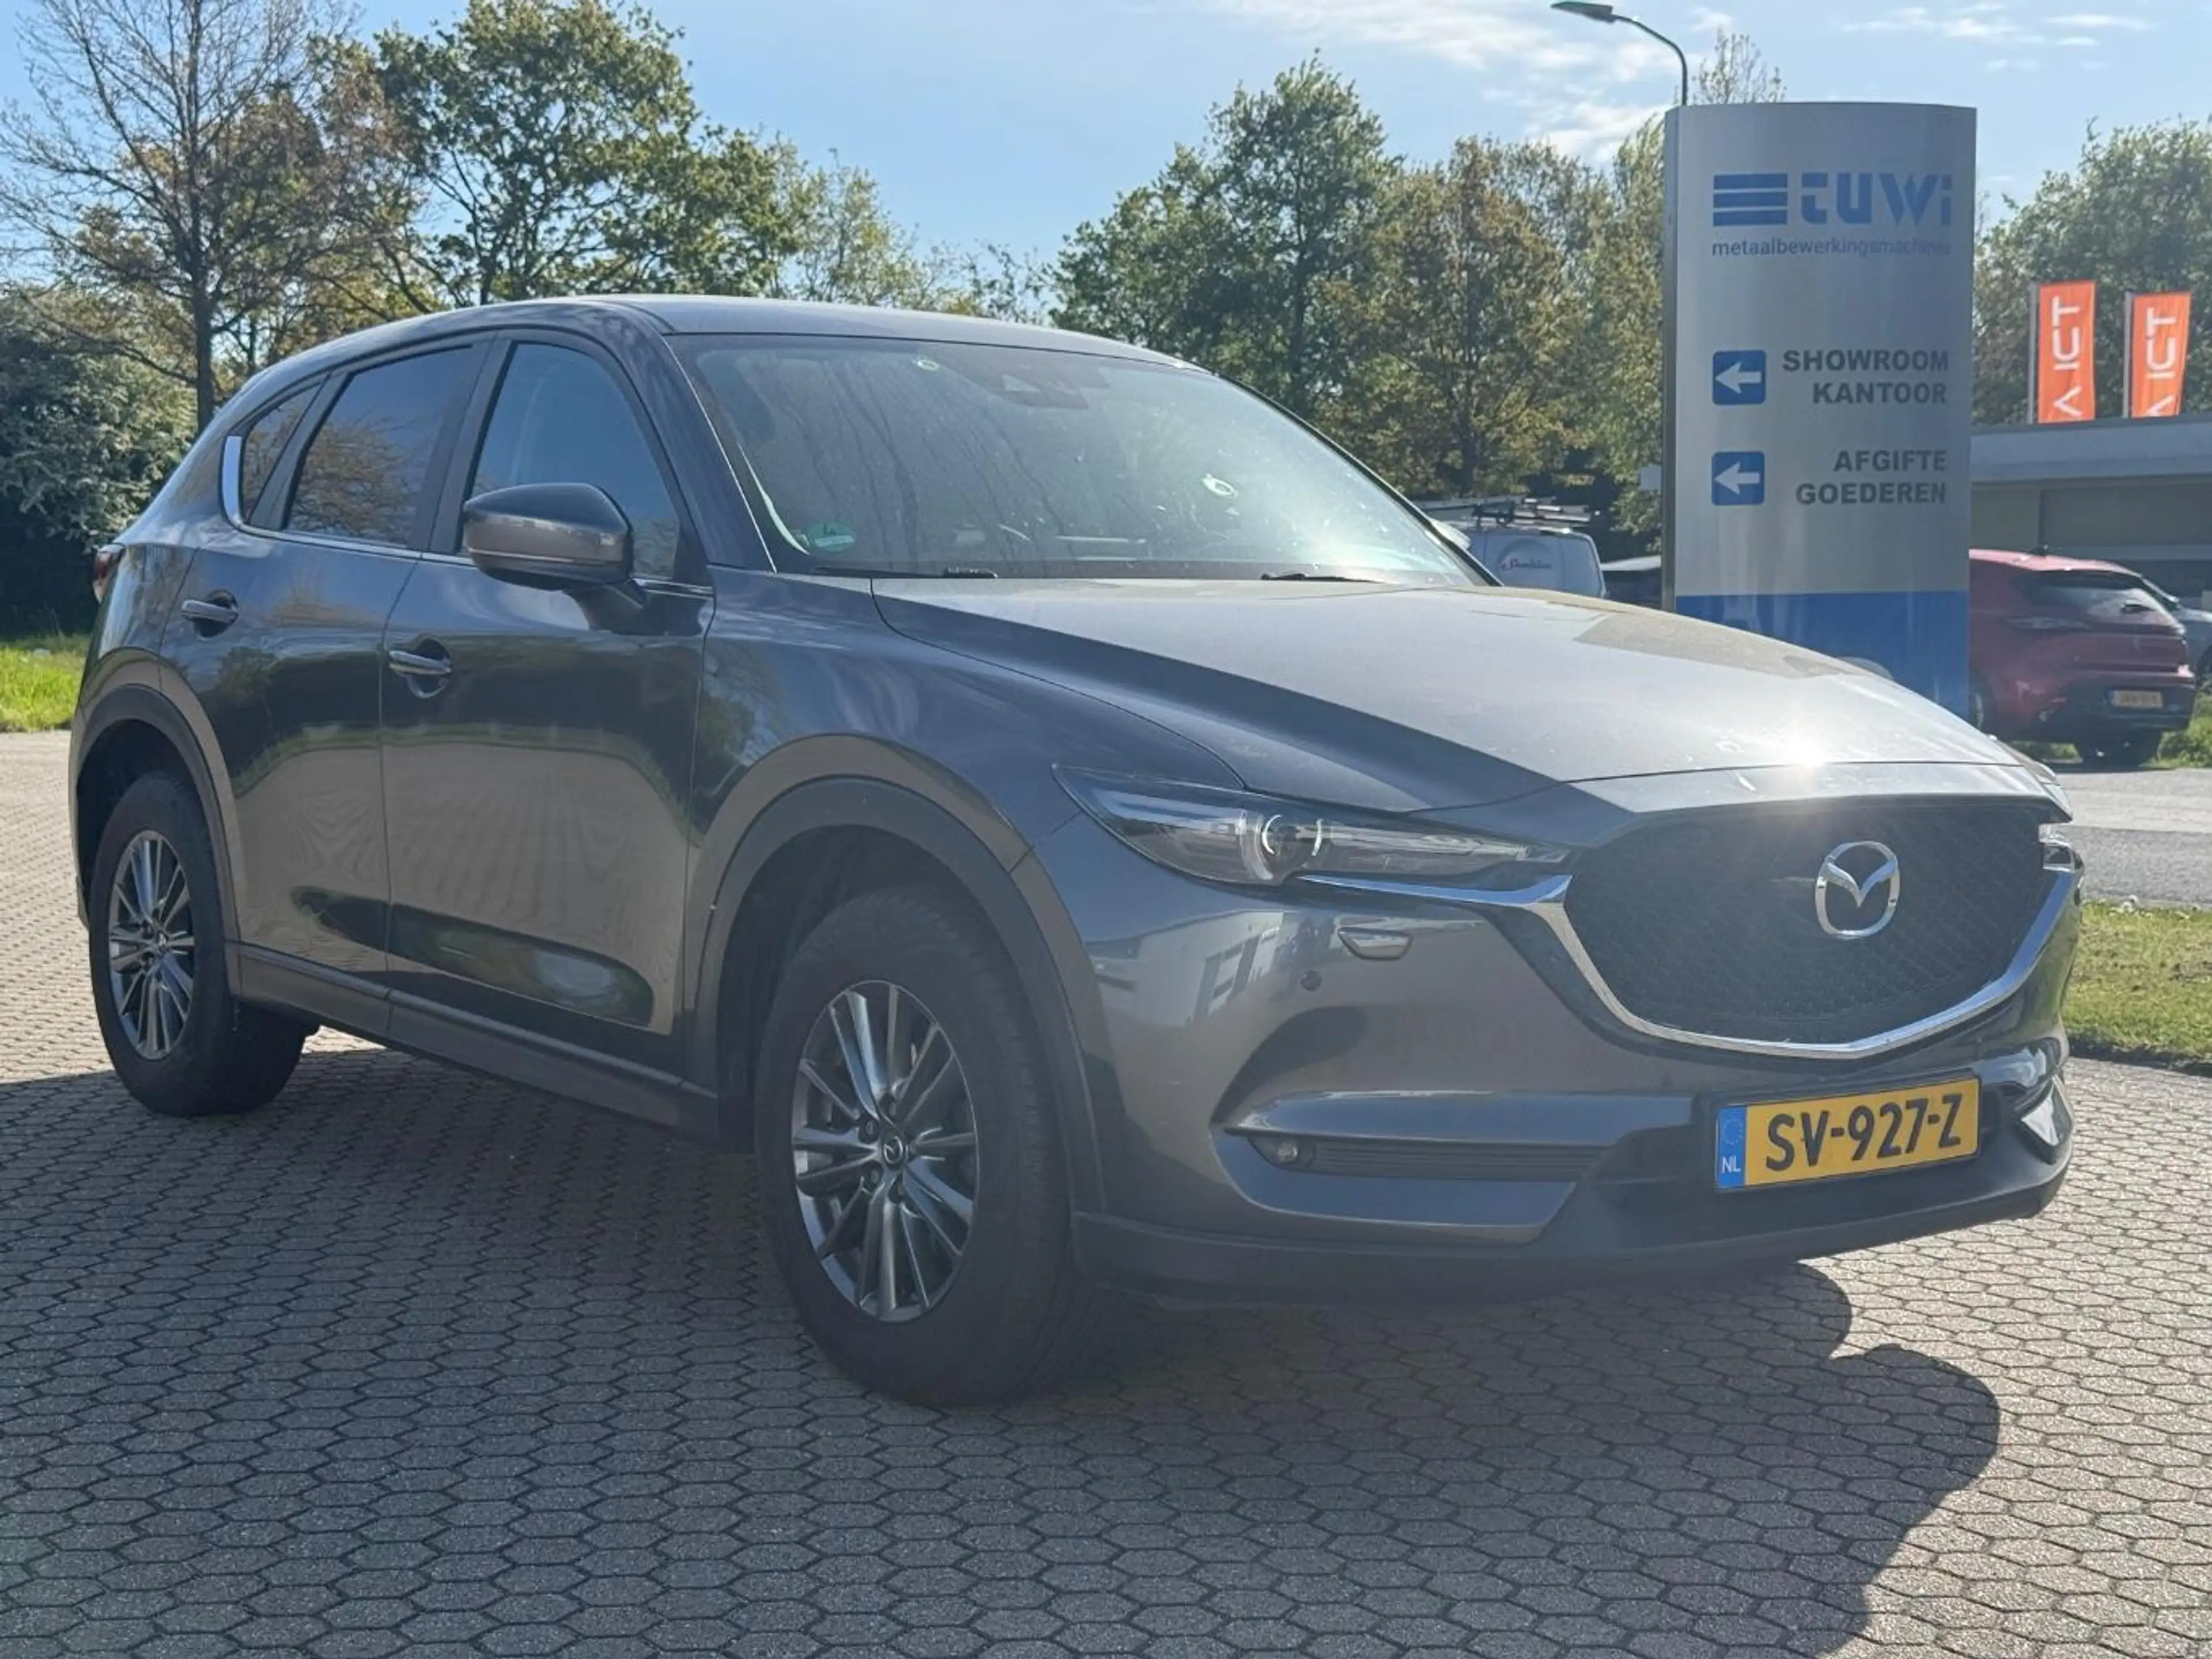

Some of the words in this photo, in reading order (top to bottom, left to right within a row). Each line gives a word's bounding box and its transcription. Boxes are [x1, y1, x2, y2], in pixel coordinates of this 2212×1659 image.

[1782, 349, 1949, 372] SHOWROOM
[1813, 382, 1946, 404] KANTOOR
[1833, 449, 1946, 472] AFGIFTE
[1795, 483, 1946, 505] GOEDEREN
[1766, 1093, 1962, 1171] SV-927-Z
[1722, 1157, 1741, 1173] NL
